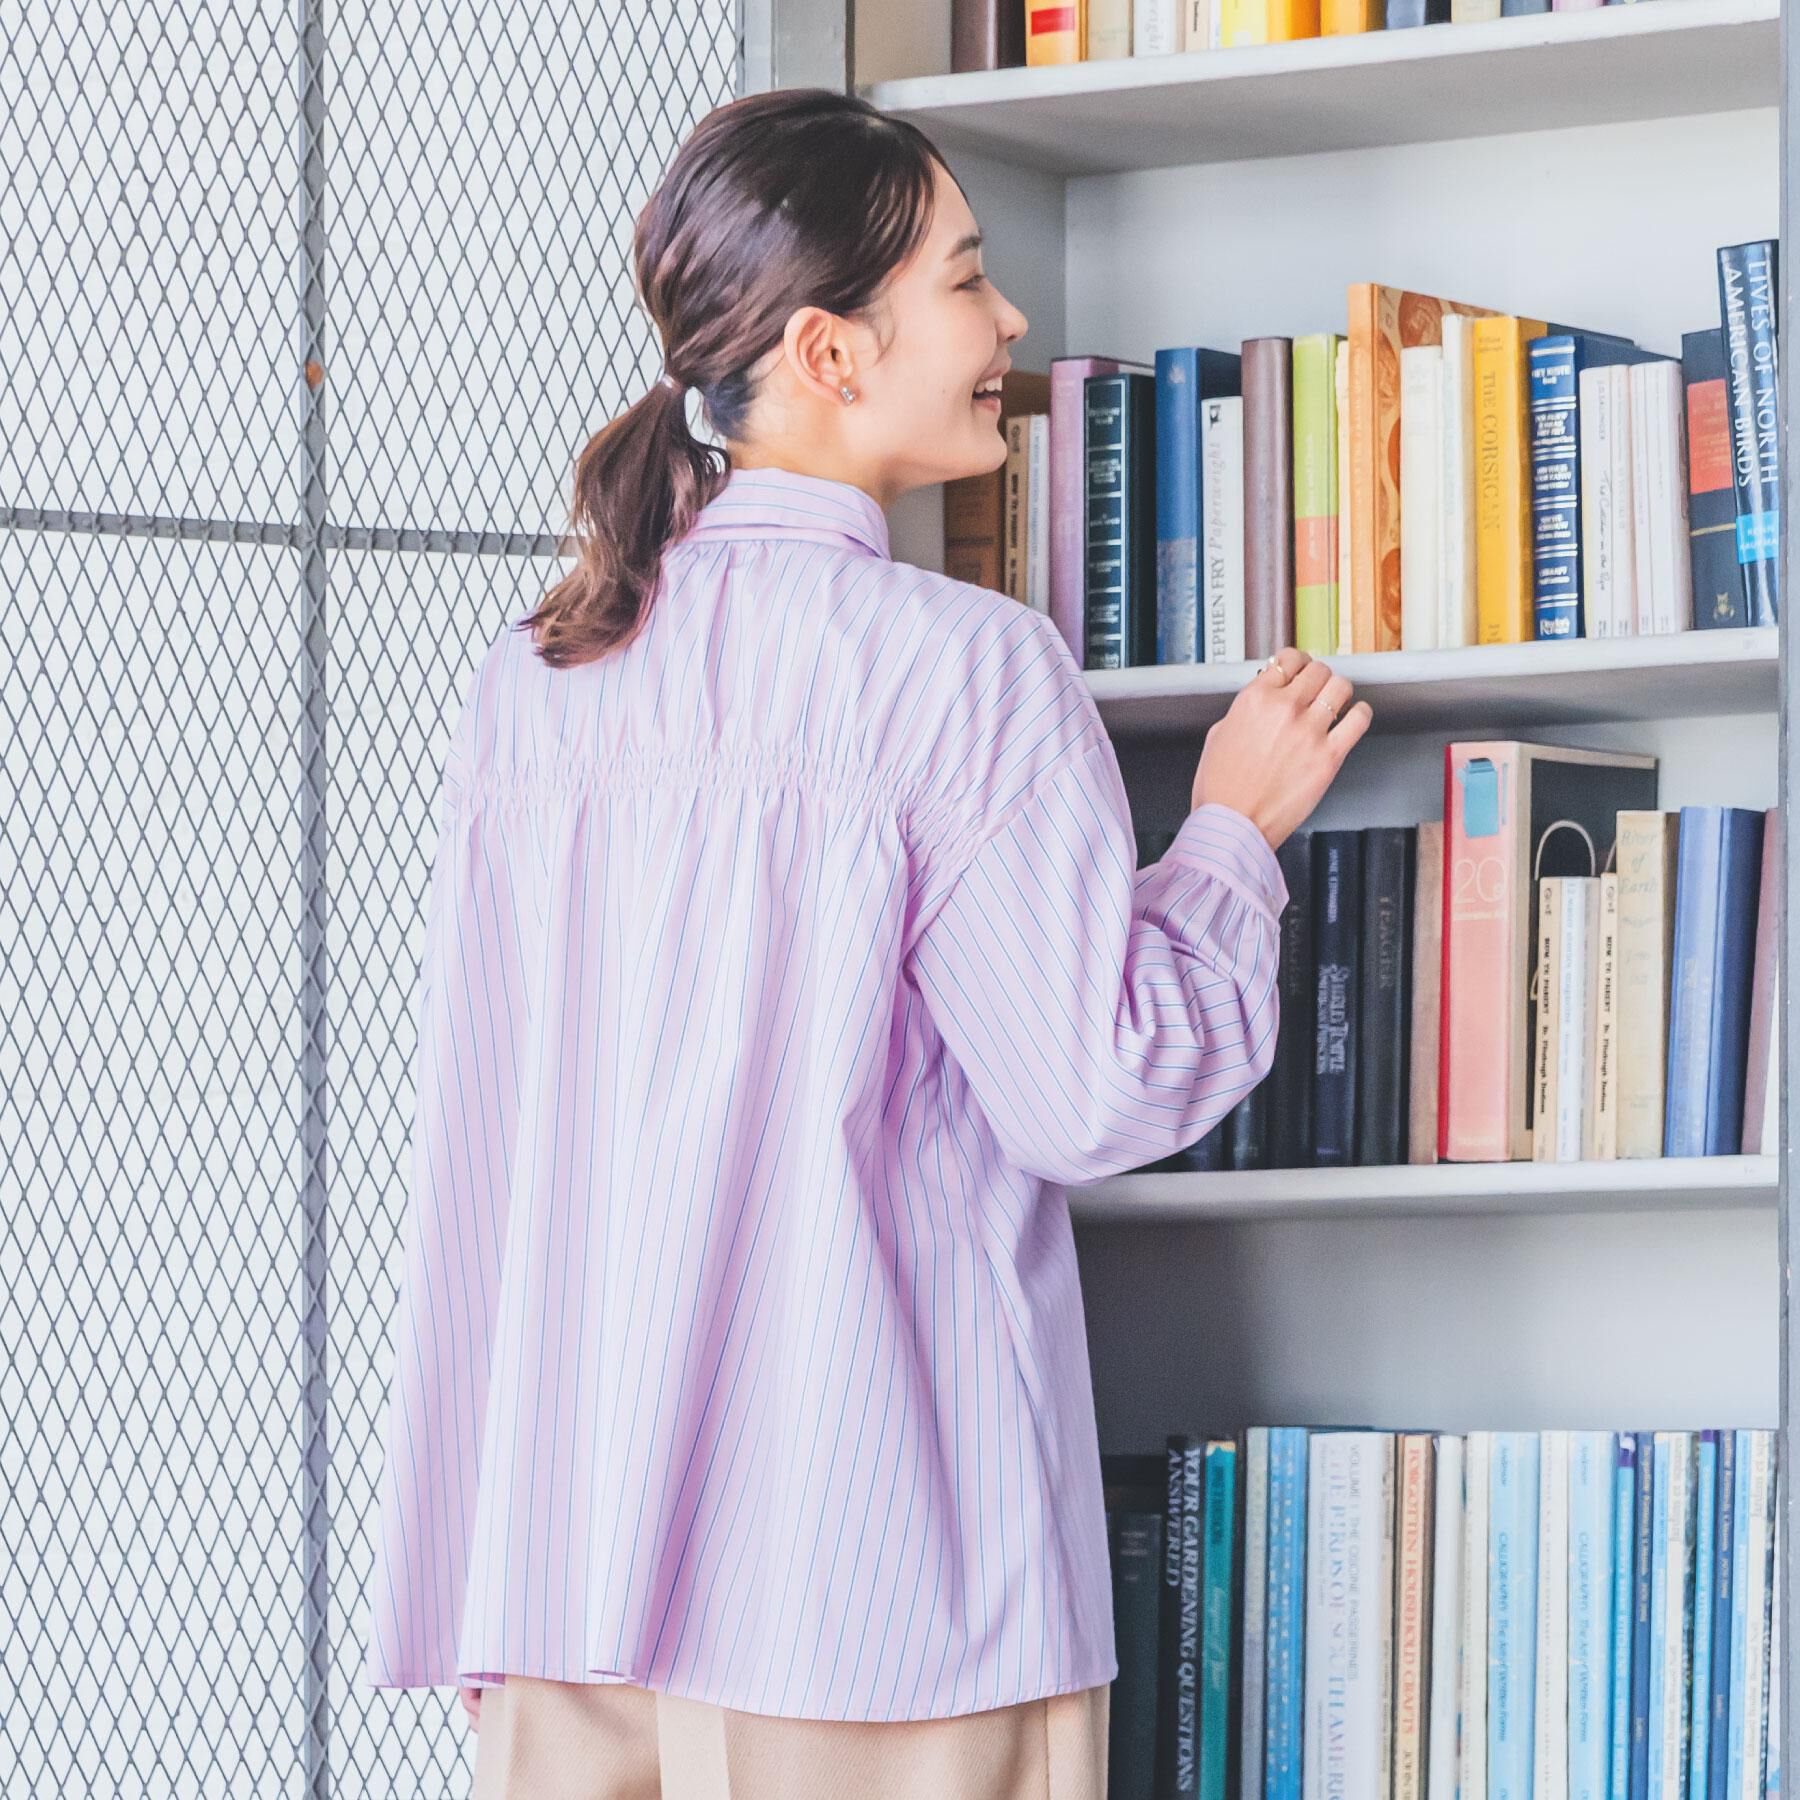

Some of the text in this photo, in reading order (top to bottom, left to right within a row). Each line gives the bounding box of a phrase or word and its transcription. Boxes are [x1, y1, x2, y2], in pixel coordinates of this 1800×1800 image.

[1481, 370, 1497, 409] THE
[1724, 266, 1755, 488] AMERICAN BIRDS
[1747, 260, 1778, 484] LIVES OF NORTH
[1481, 413, 1501, 534] CORSICAN
[1210, 554, 1225, 590] FRY
[1211, 594, 1226, 663] TEPHEN
[1165, 1449, 1183, 1587] ANSWERED
[1329, 1505, 1347, 1577] BIRDS
[1406, 1448, 1420, 1552] FORGOTTEN
[1176, 1447, 1201, 1792] YOUR GARDENING QUESTIONS
[1329, 1582, 1347, 1616] OF
[1404, 1559, 1418, 1665] HOUSEHOLD
[1328, 1621, 1346, 1707] SOUTH
[1402, 1670, 1416, 1736] CRAFTS
